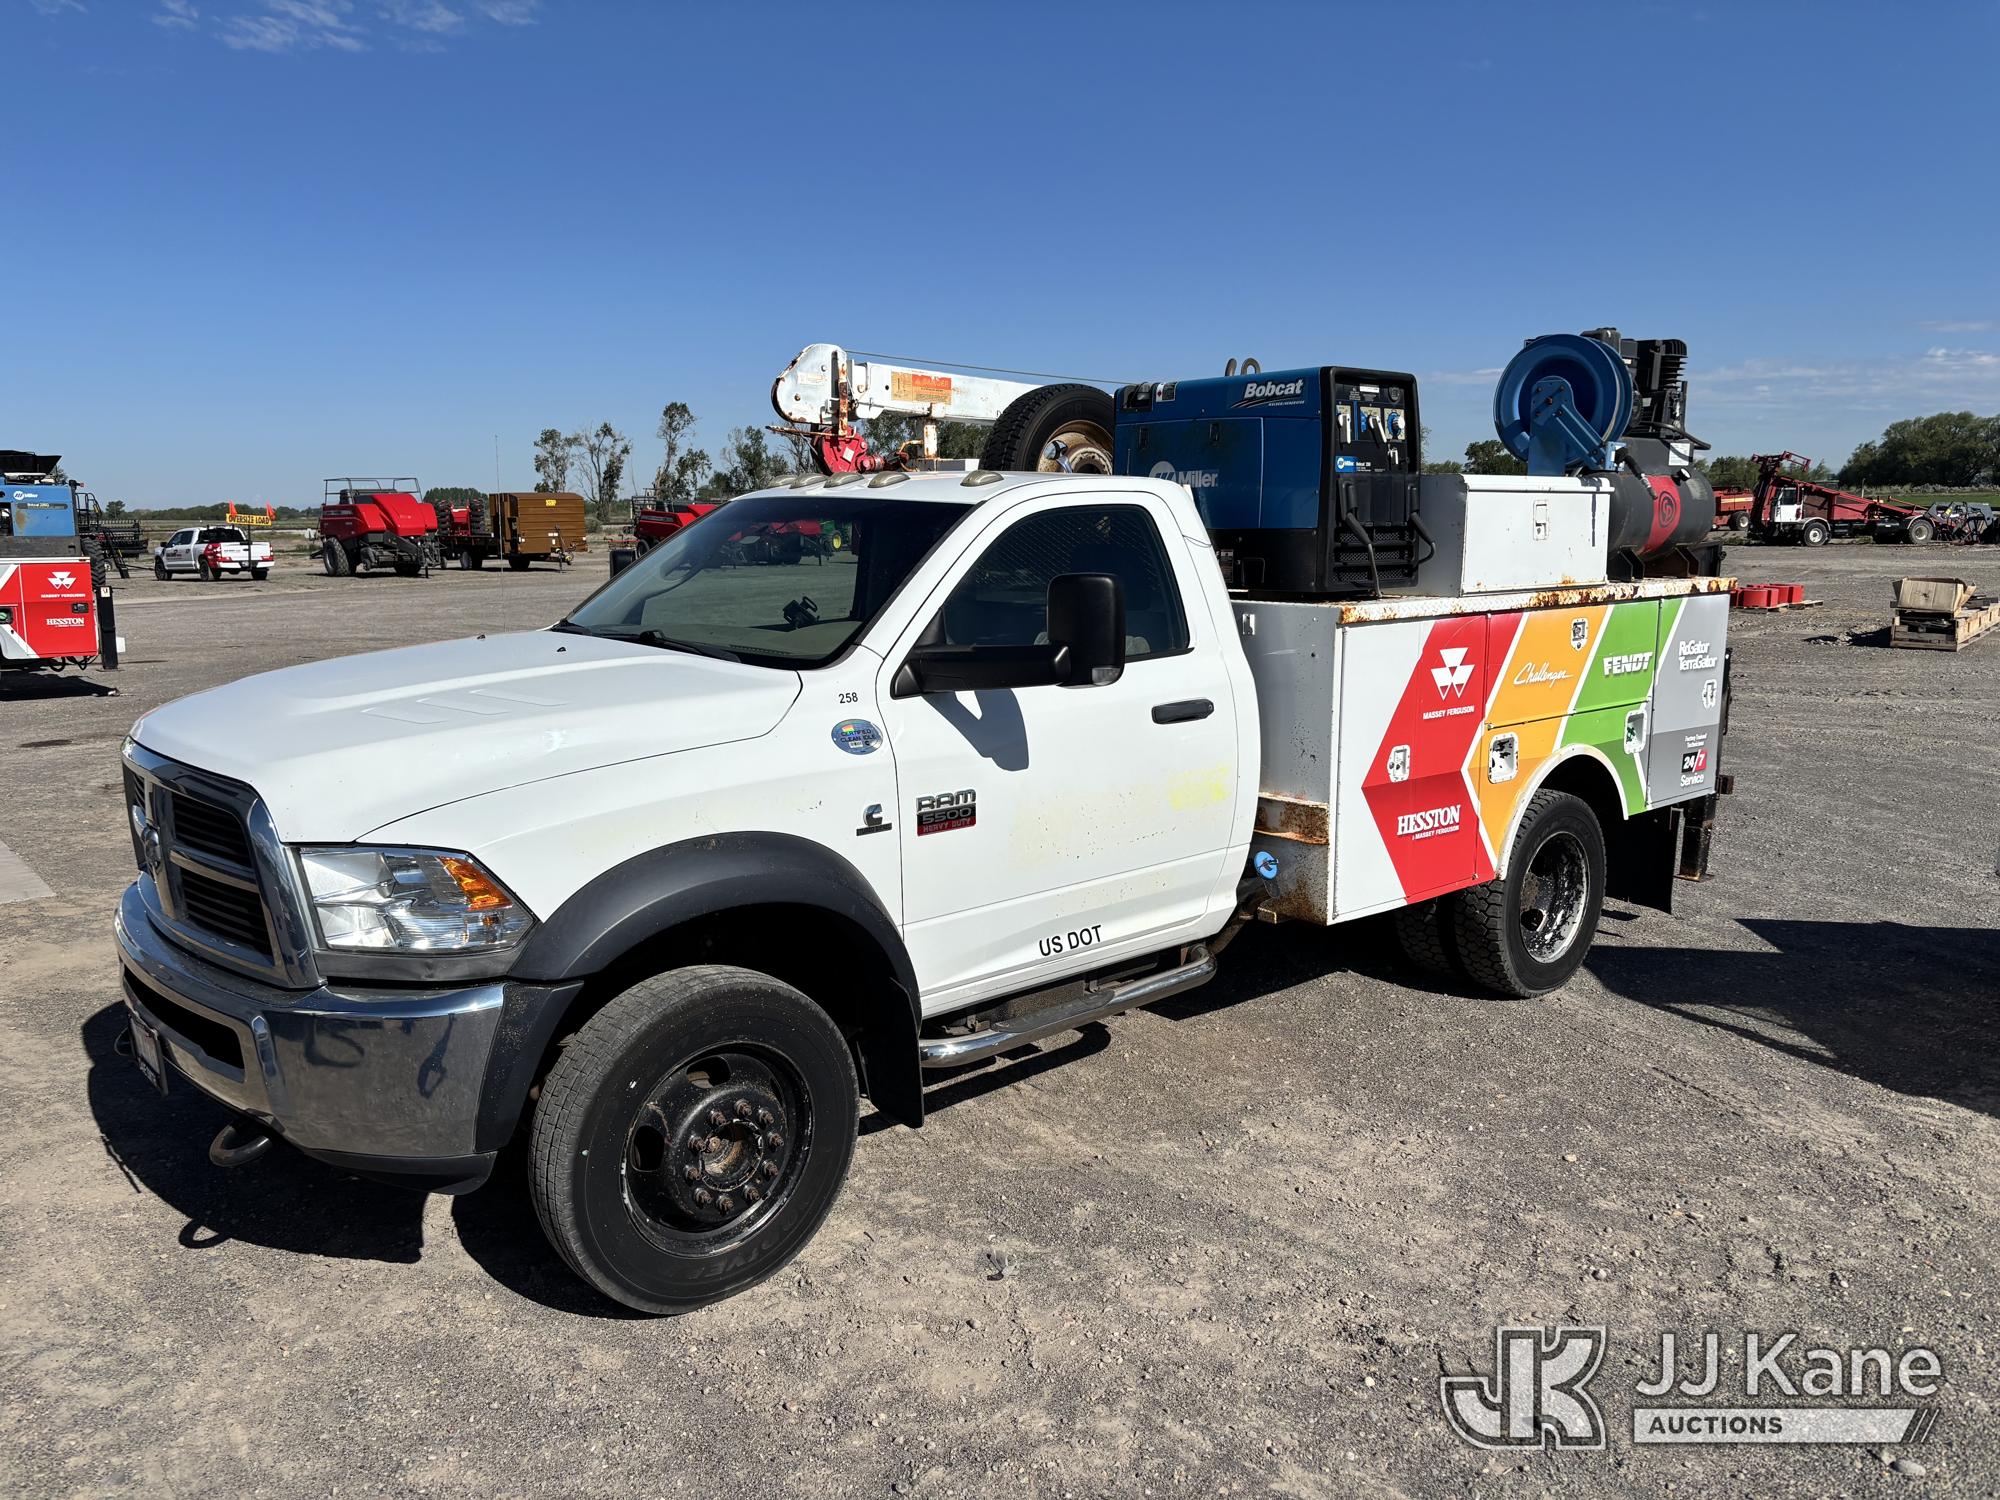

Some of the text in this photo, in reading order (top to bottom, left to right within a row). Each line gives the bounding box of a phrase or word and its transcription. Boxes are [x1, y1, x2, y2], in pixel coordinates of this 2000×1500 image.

[1244, 379, 1304, 399] Bobcat
[1178, 470, 1218, 488] Miller
[228, 514, 270, 525] OVERSIZE LOAD
[46, 617, 85, 626] HESSTON
[1603, 651, 1653, 676] FENDT
[1513, 662, 1574, 688] Challenger
[838, 692, 858, 704] 258
[1423, 705, 1475, 719] MASSEY FERGUSON
[1683, 749, 1705, 772] 24/7
[1680, 773, 1704, 787] Service
[916, 789, 977, 812] RAM
[922, 807, 972, 825] 5500
[1397, 804, 1461, 836] HESSTON
[923, 818, 972, 833] HEAVY DUTY
[1415, 830, 1435, 840] MASSEY
[1039, 924, 1102, 956] US DOT
